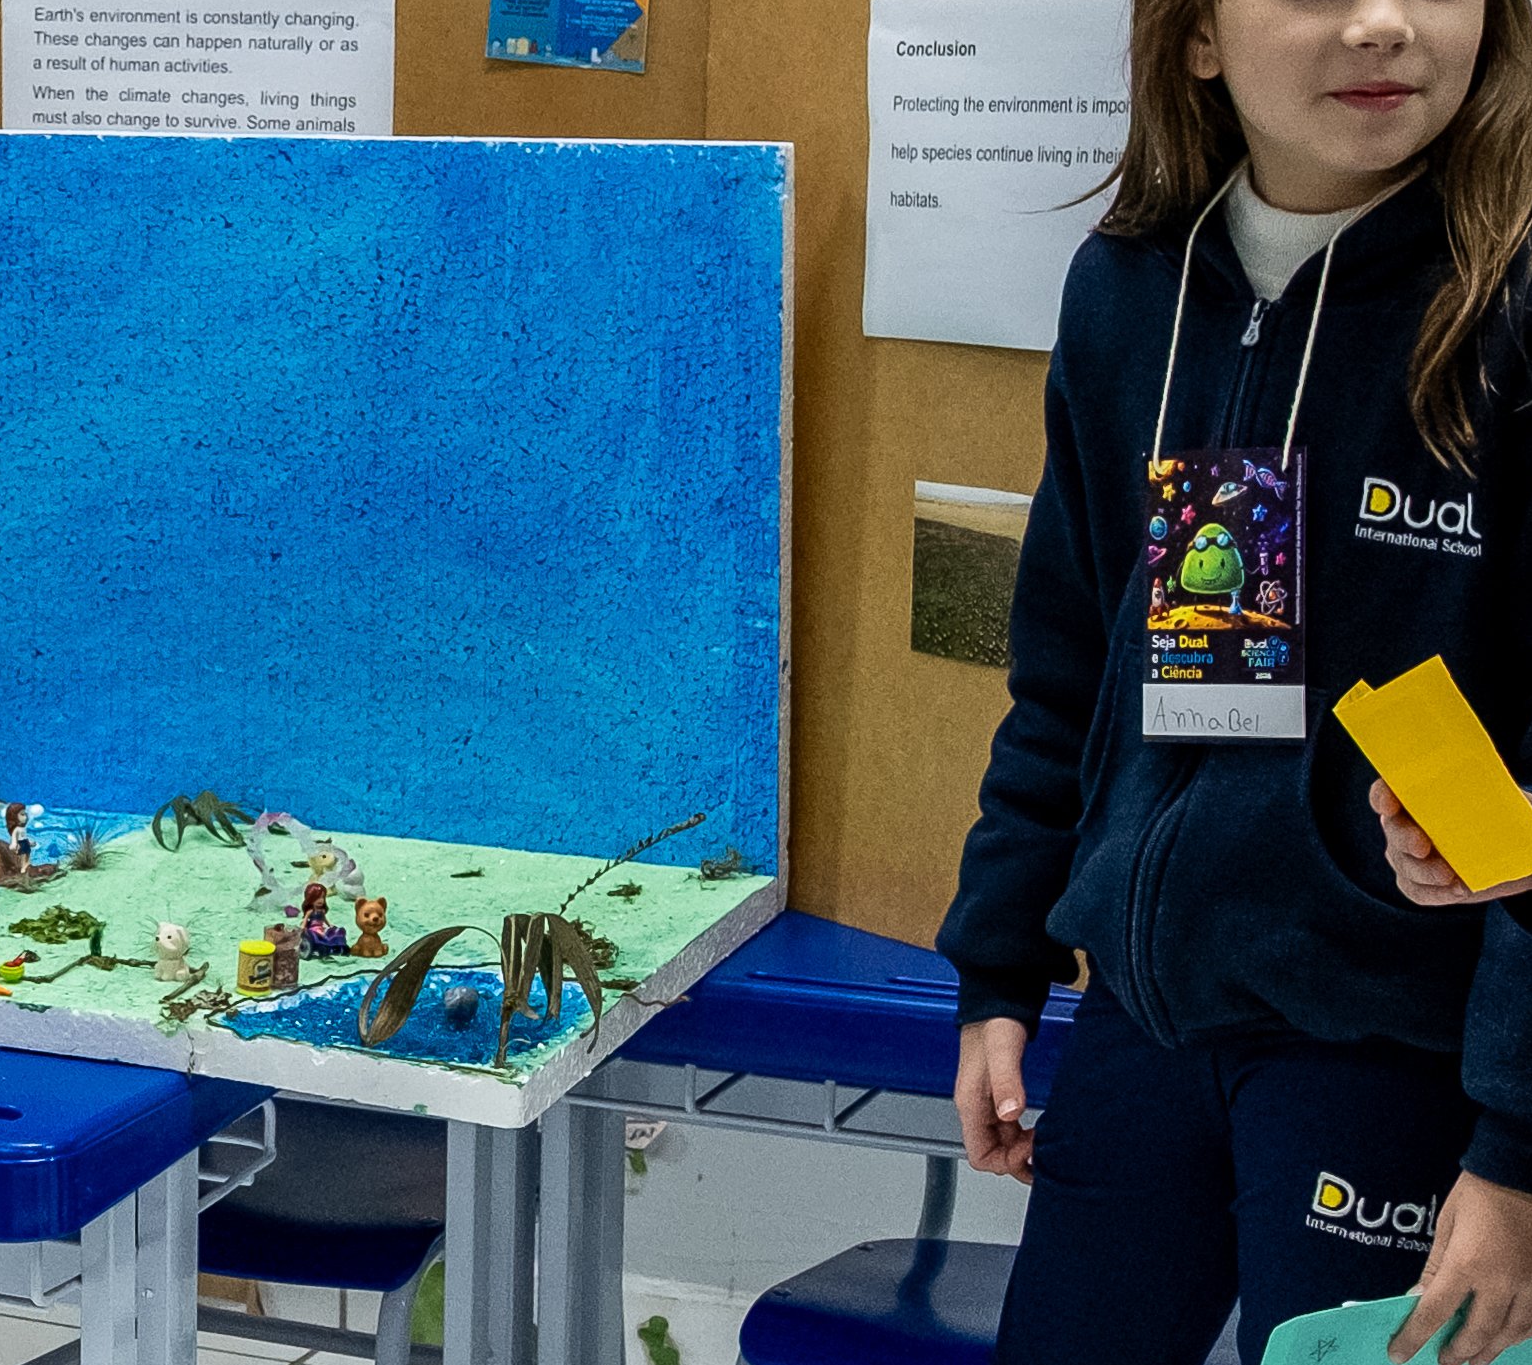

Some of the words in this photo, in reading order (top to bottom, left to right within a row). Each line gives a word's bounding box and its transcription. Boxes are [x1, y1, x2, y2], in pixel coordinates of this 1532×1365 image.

[35, 7, 85, 23] Earth's
[90, 11, 181, 24] environment
[186, 13, 198, 25] is
[203, 10, 280, 30] constantly
[285, 11, 359, 31] changing.
[896, 40, 977, 57] Conclusion
[32, 85, 75, 101] When
[85, 87, 109, 102] the
[119, 88, 171, 103] climate
[181, 90, 249, 109] changes,
[260, 91, 300, 111] living
[311, 93, 357, 112] things
[894, 95, 960, 117] Protecting
[964, 96, 985, 113] the
[988, 96, 1073, 114] environment
[1076, 96, 1088, 114] is
[1092, 96, 1131, 117] impor
[892, 144, 918, 163] help
[922, 145, 972, 164] species
[976, 145, 1034, 163] continue
[1038, 146, 1073, 167] living
[1076, 146, 1089, 164] in
[890, 191, 942, 209] habitats.
[1359, 477, 1482, 539] Dual
[1355, 523, 1438, 551] International
[1442, 539, 1482, 557] School
[1151, 635, 1176, 651] Seja
[1179, 634, 1209, 648] Dual
[1151, 653, 1159, 663] e
[1161, 651, 1214, 664] descubra
[1151, 669, 1159, 679] a
[1161, 665, 1203, 679] Ciência
[1312, 1171, 1436, 1236] Dual
[1305, 1214, 1393, 1247] International
[1396, 1237, 1433, 1252] Schoo
